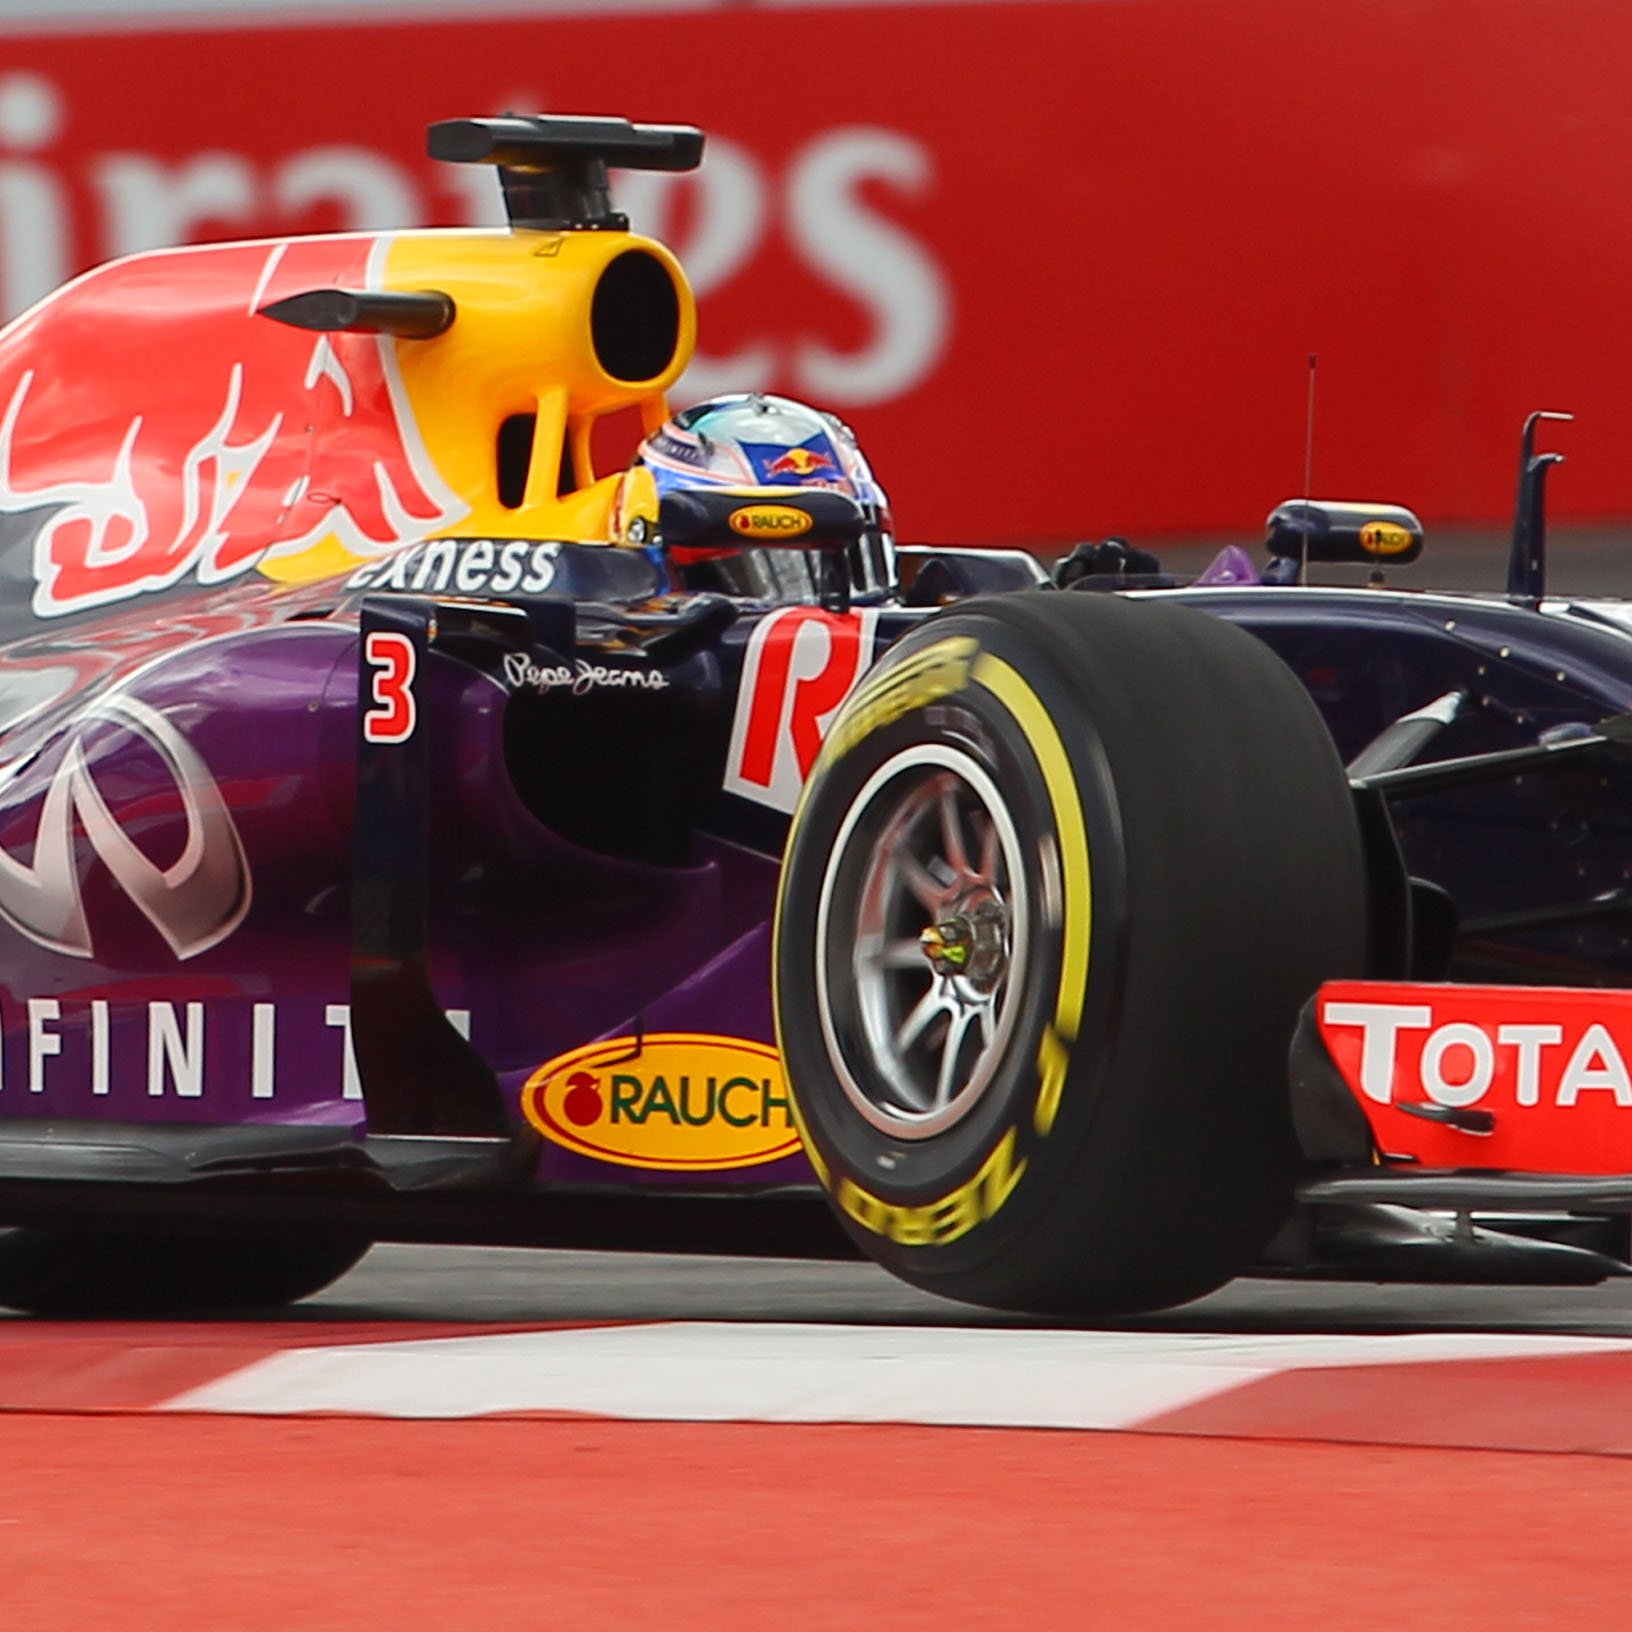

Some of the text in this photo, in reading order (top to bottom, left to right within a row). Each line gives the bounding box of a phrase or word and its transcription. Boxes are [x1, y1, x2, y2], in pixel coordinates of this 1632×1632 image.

[364, 632, 416, 744] 3
[503, 652, 671, 696] Pepe Jeans
[609, 1074, 796, 1129] RAUCH
